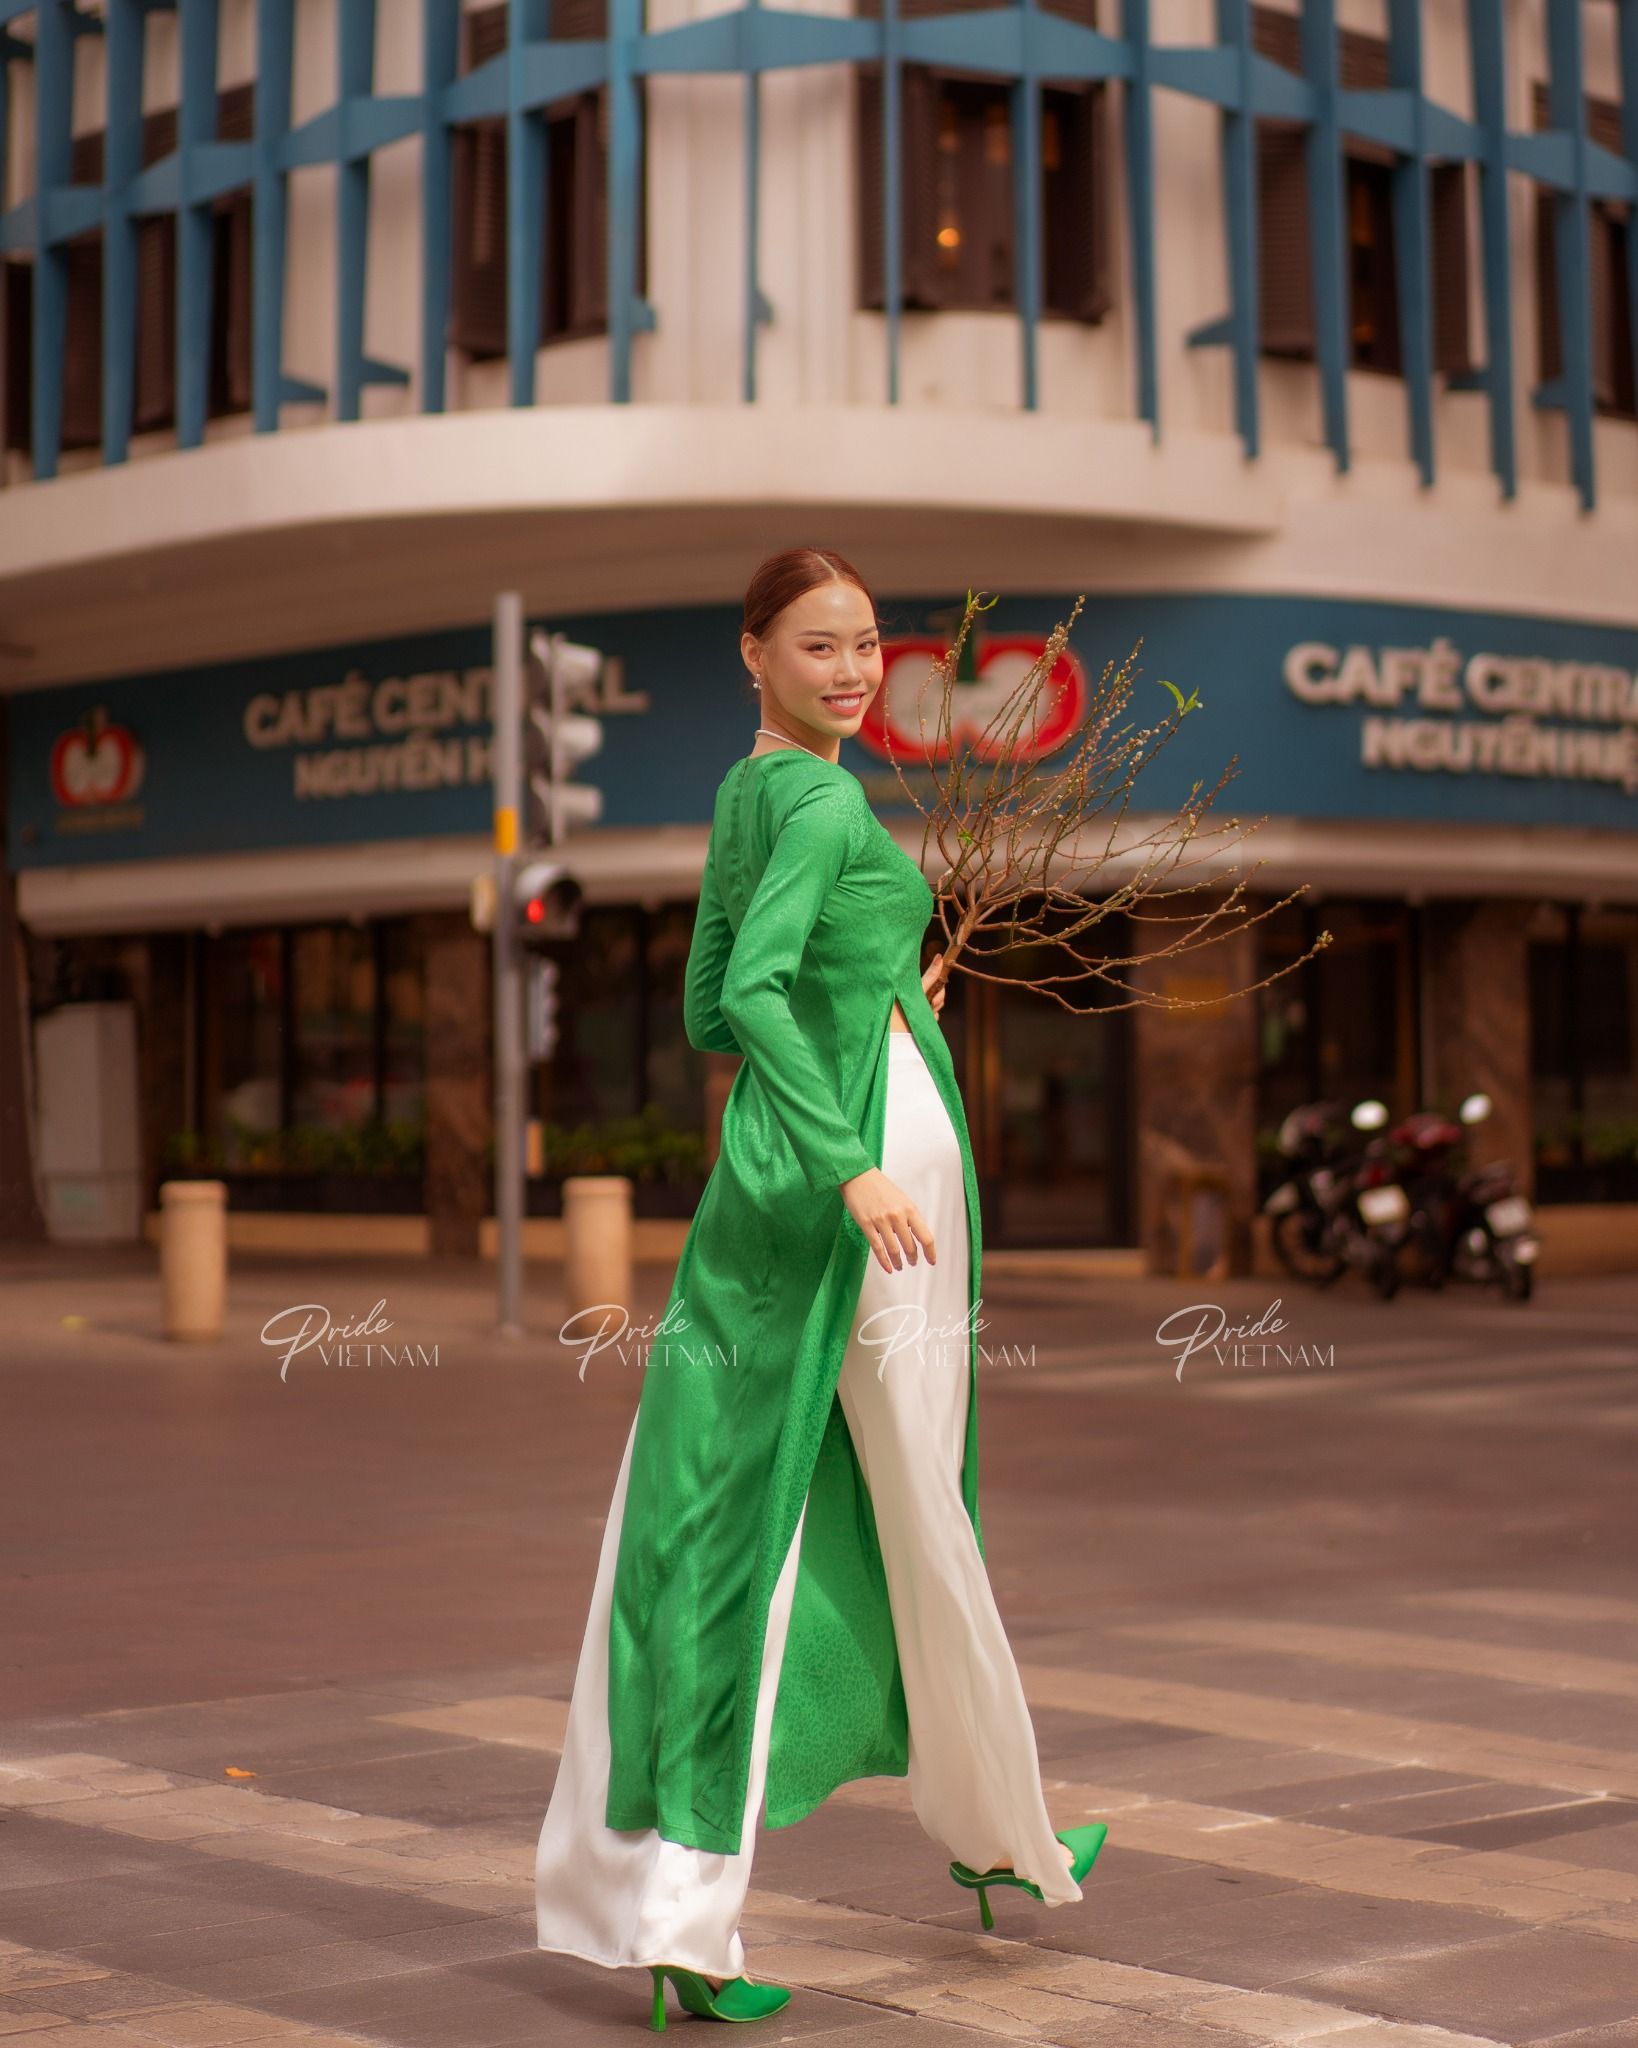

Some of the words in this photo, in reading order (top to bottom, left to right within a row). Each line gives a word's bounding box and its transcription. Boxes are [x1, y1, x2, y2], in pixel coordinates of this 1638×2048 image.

[244, 670, 371, 748] CAFÉ
[1283, 637, 1463, 708] CAFÉ
[1466, 653, 1638, 720] CENTR
